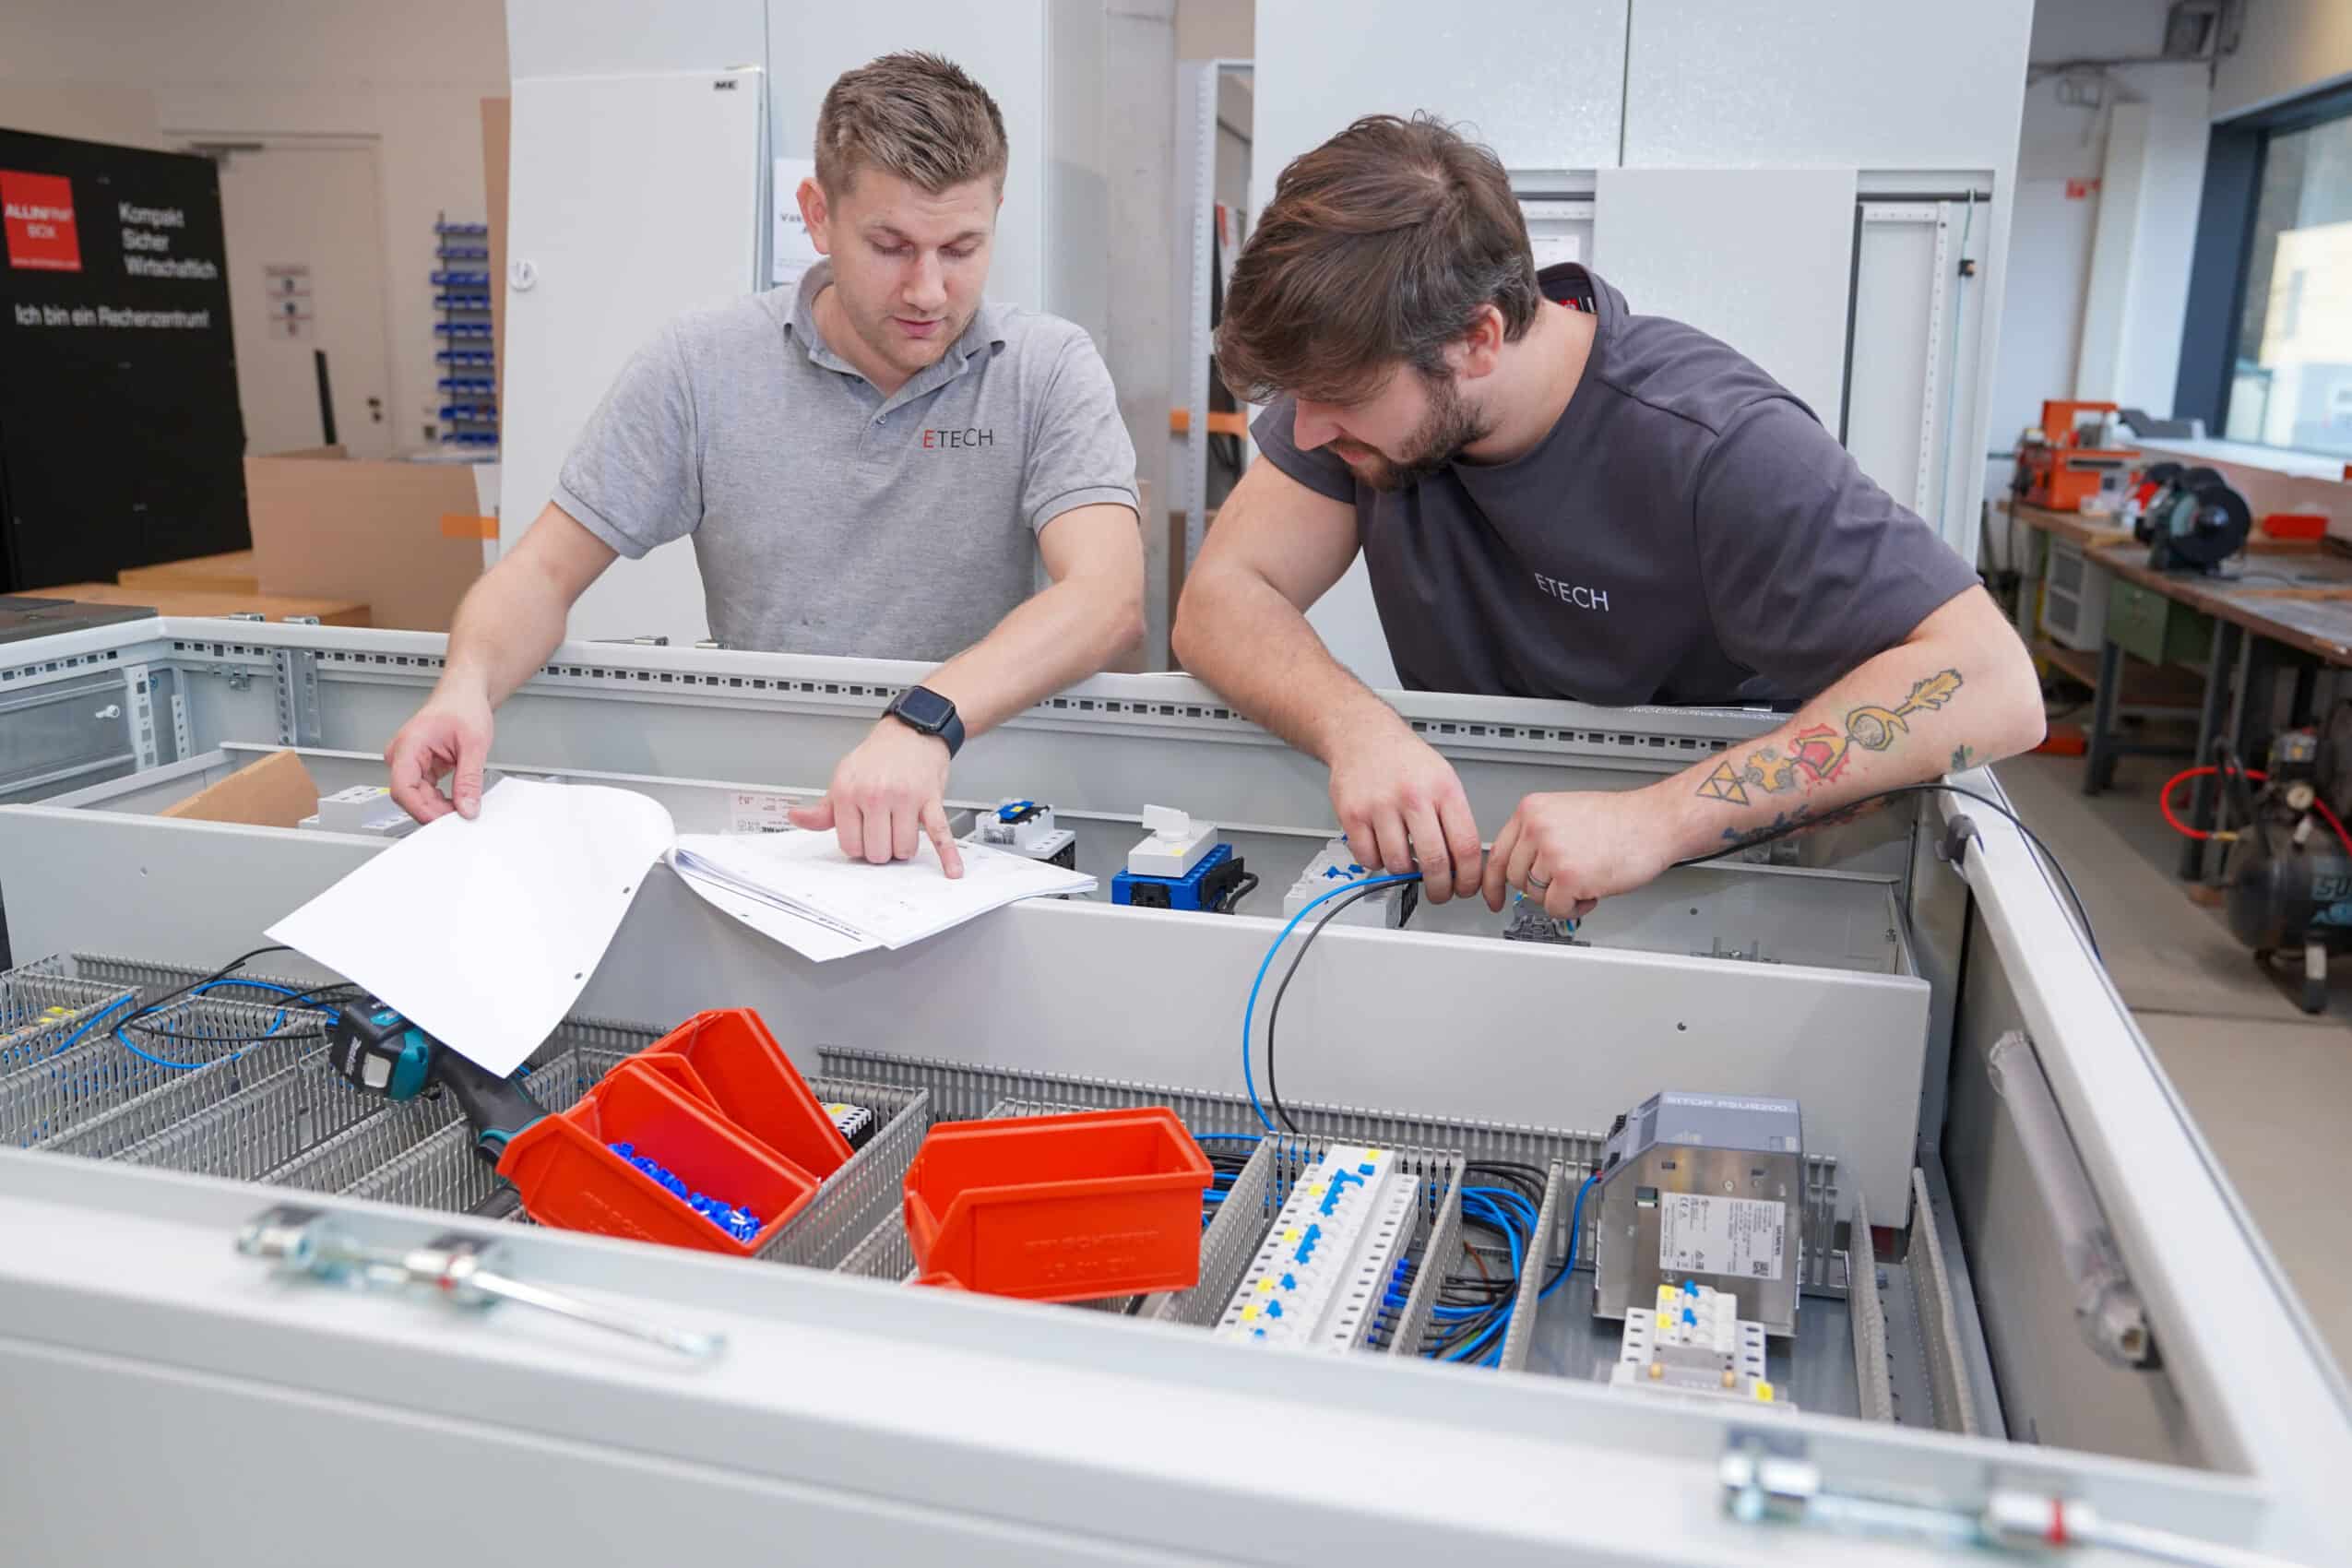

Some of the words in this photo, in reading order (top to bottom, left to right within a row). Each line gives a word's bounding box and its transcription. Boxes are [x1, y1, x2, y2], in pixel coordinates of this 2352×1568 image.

[119, 202, 184, 227] Kompakt
[122, 229, 169, 251] Sicher
[125, 256, 218, 278] Wirtschaftlich
[15, 303, 42, 326] Ich
[42, 303, 70, 326] bin
[71, 306, 97, 326] ein
[923, 428, 993, 448] ETECH
[1535, 572, 1609, 612] ETECH
